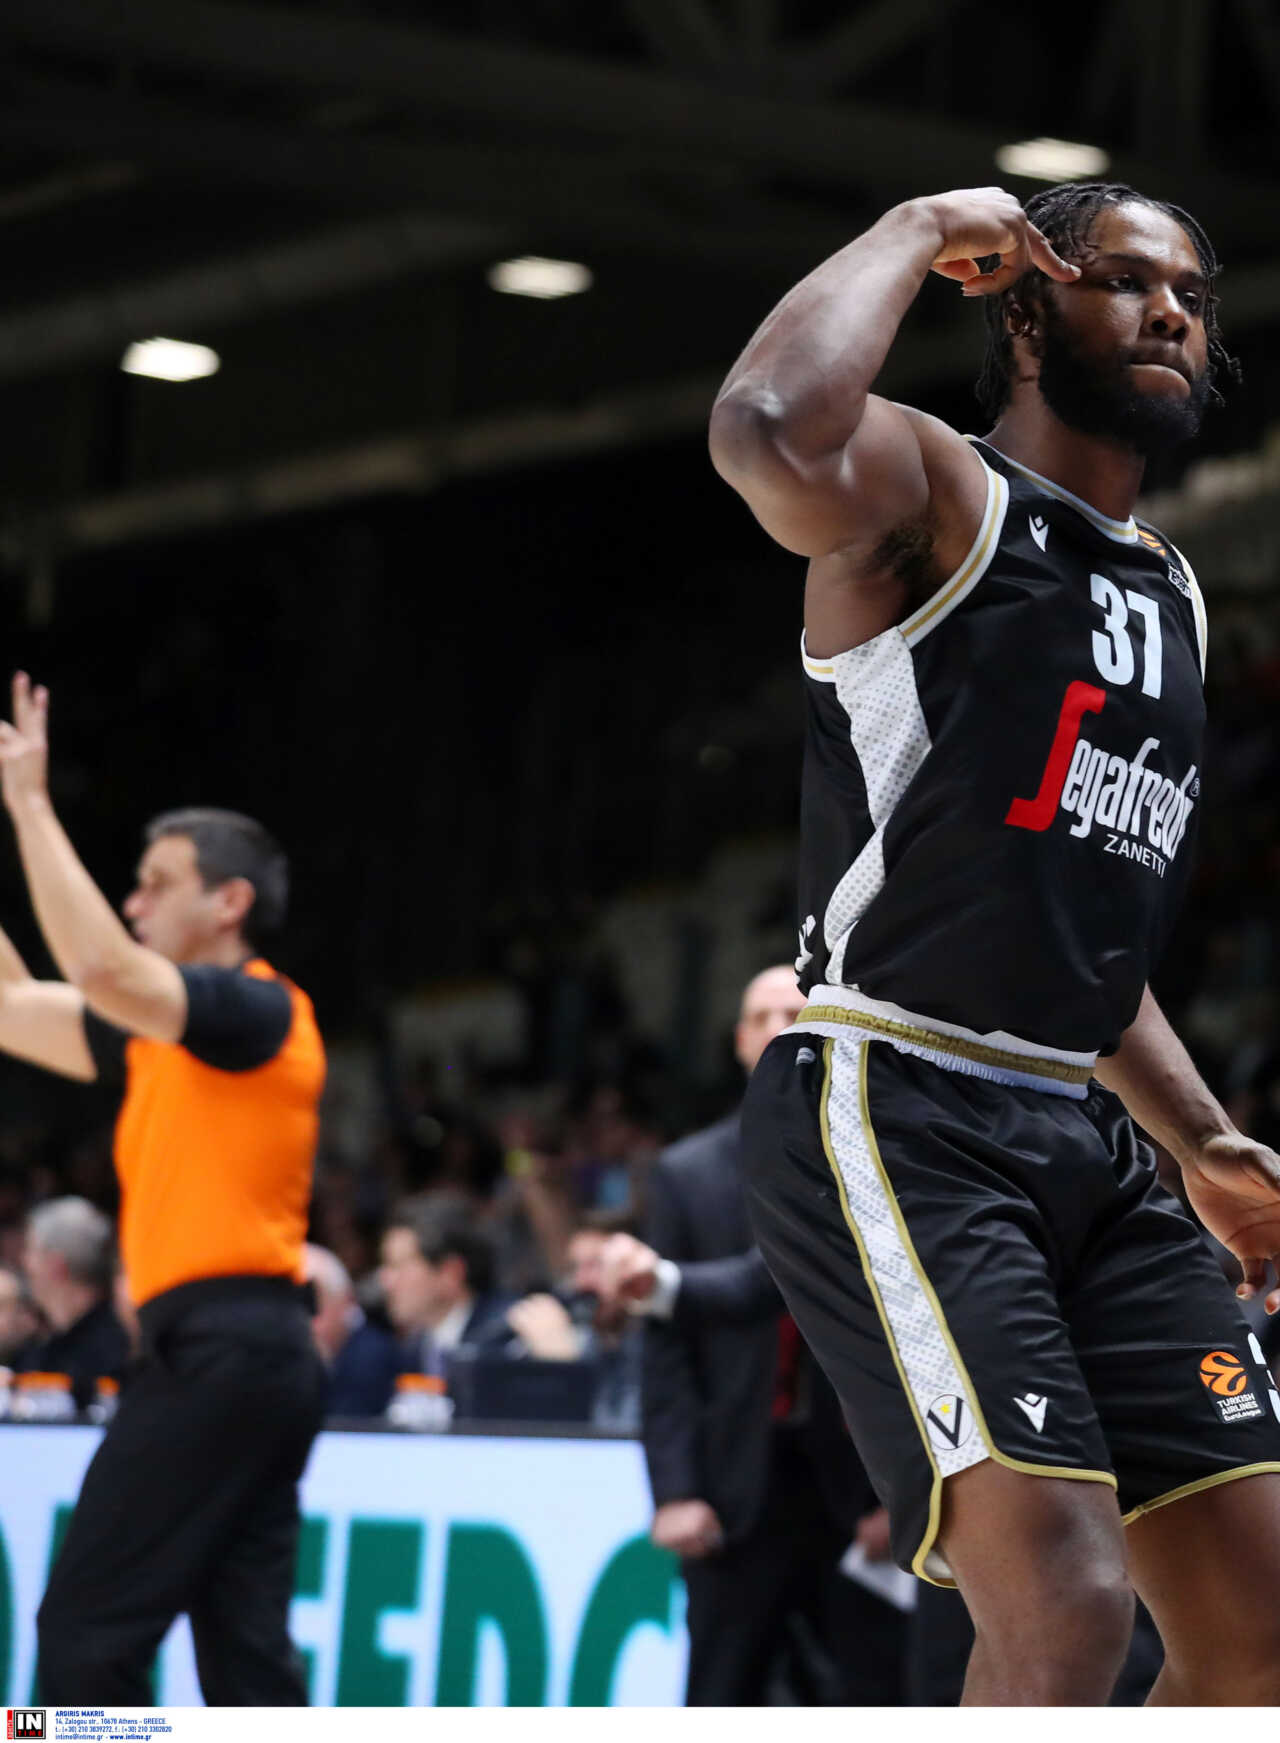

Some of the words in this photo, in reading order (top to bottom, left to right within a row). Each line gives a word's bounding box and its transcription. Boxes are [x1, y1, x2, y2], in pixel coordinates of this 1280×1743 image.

[1090, 573, 1162, 699] 37
[1103, 834, 1167, 878] ZANETTI
[1216, 1392, 1256, 1408] TURKISH
